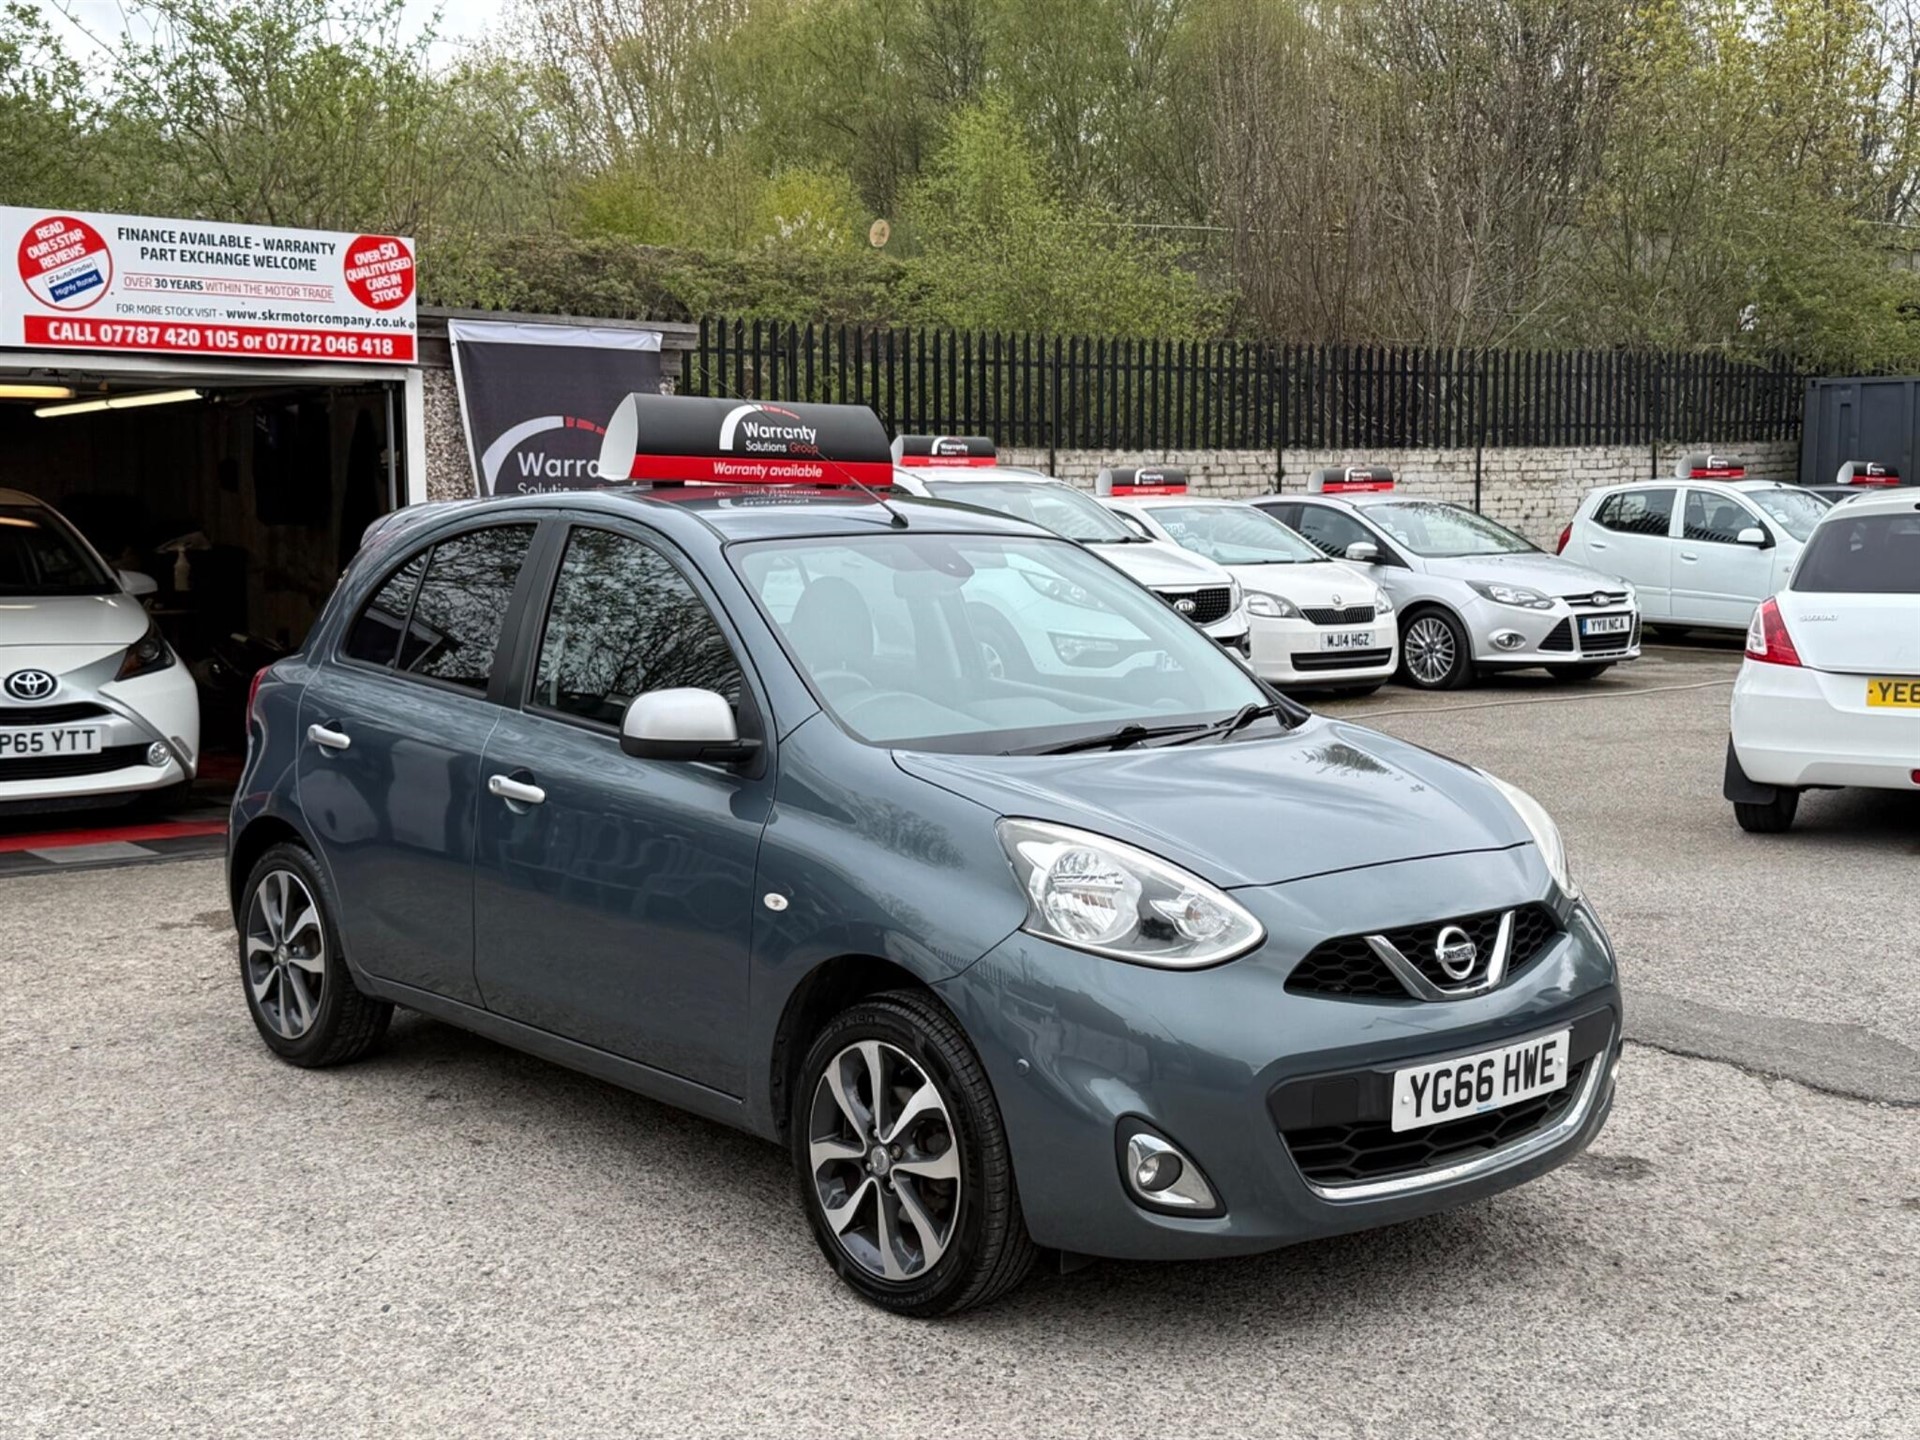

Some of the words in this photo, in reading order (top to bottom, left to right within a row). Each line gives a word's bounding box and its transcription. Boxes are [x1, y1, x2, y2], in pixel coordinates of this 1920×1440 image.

[35, 221, 65, 240] READ
[118, 227, 177, 243] FINANCE
[180, 231, 252, 249] AVAILABLE
[263, 238, 336, 255] WARRANTY
[27, 241, 50, 260] OUR
[48, 239, 59, 251] 5
[56, 228, 85, 247] STAR
[354, 249, 382, 266] OVER
[378, 242, 399, 260] 50
[39, 243, 86, 270] REVIEWS
[140, 247, 177, 261] PART
[180, 250, 250, 266] EXCHANGE
[253, 254, 317, 271] WELCOME
[346, 262, 387, 283] QUALITY
[385, 256, 412, 273] USED
[54, 282, 77, 297] Highly
[124, 276, 152, 288] OVER
[154, 278, 168, 288] 30
[169, 279, 204, 291] YEARS
[205, 281, 242, 294] WITHIN
[244, 284, 263, 295] THE
[265, 285, 300, 297] MOTOR
[303, 288, 334, 299] TRADE
[366, 275, 391, 291] CARS
[371, 286, 405, 304] STOCK
[117, 303, 135, 314] FOR
[137, 305, 163, 316] MORE
[165, 306, 194, 317] STOCK
[194, 308, 217, 318] VISIT
[226, 309, 406, 328] www.skrmotorcompany.co.uk
[48, 322, 96, 342] CALL
[100, 324, 160, 344] 07787
[164, 327, 200, 346] 420
[205, 329, 239, 348] 105
[242, 335, 263, 349] or
[266, 333, 321, 353] 07772
[325, 337, 358, 353] 046
[361, 338, 393, 355] 418
[742, 421, 817, 445] Warranty
[745, 440, 787, 453] Solutions
[789, 442, 818, 456] Group
[713, 461, 768, 480] Warranty
[769, 464, 823, 478] available
[1327, 634, 1350, 648] MJ14
[1351, 632, 1370, 647] HGZ
[51, 729, 96, 751] YTT
[1410, 1059, 1496, 1119] YG66
[1502, 1039, 1558, 1097] HWE
